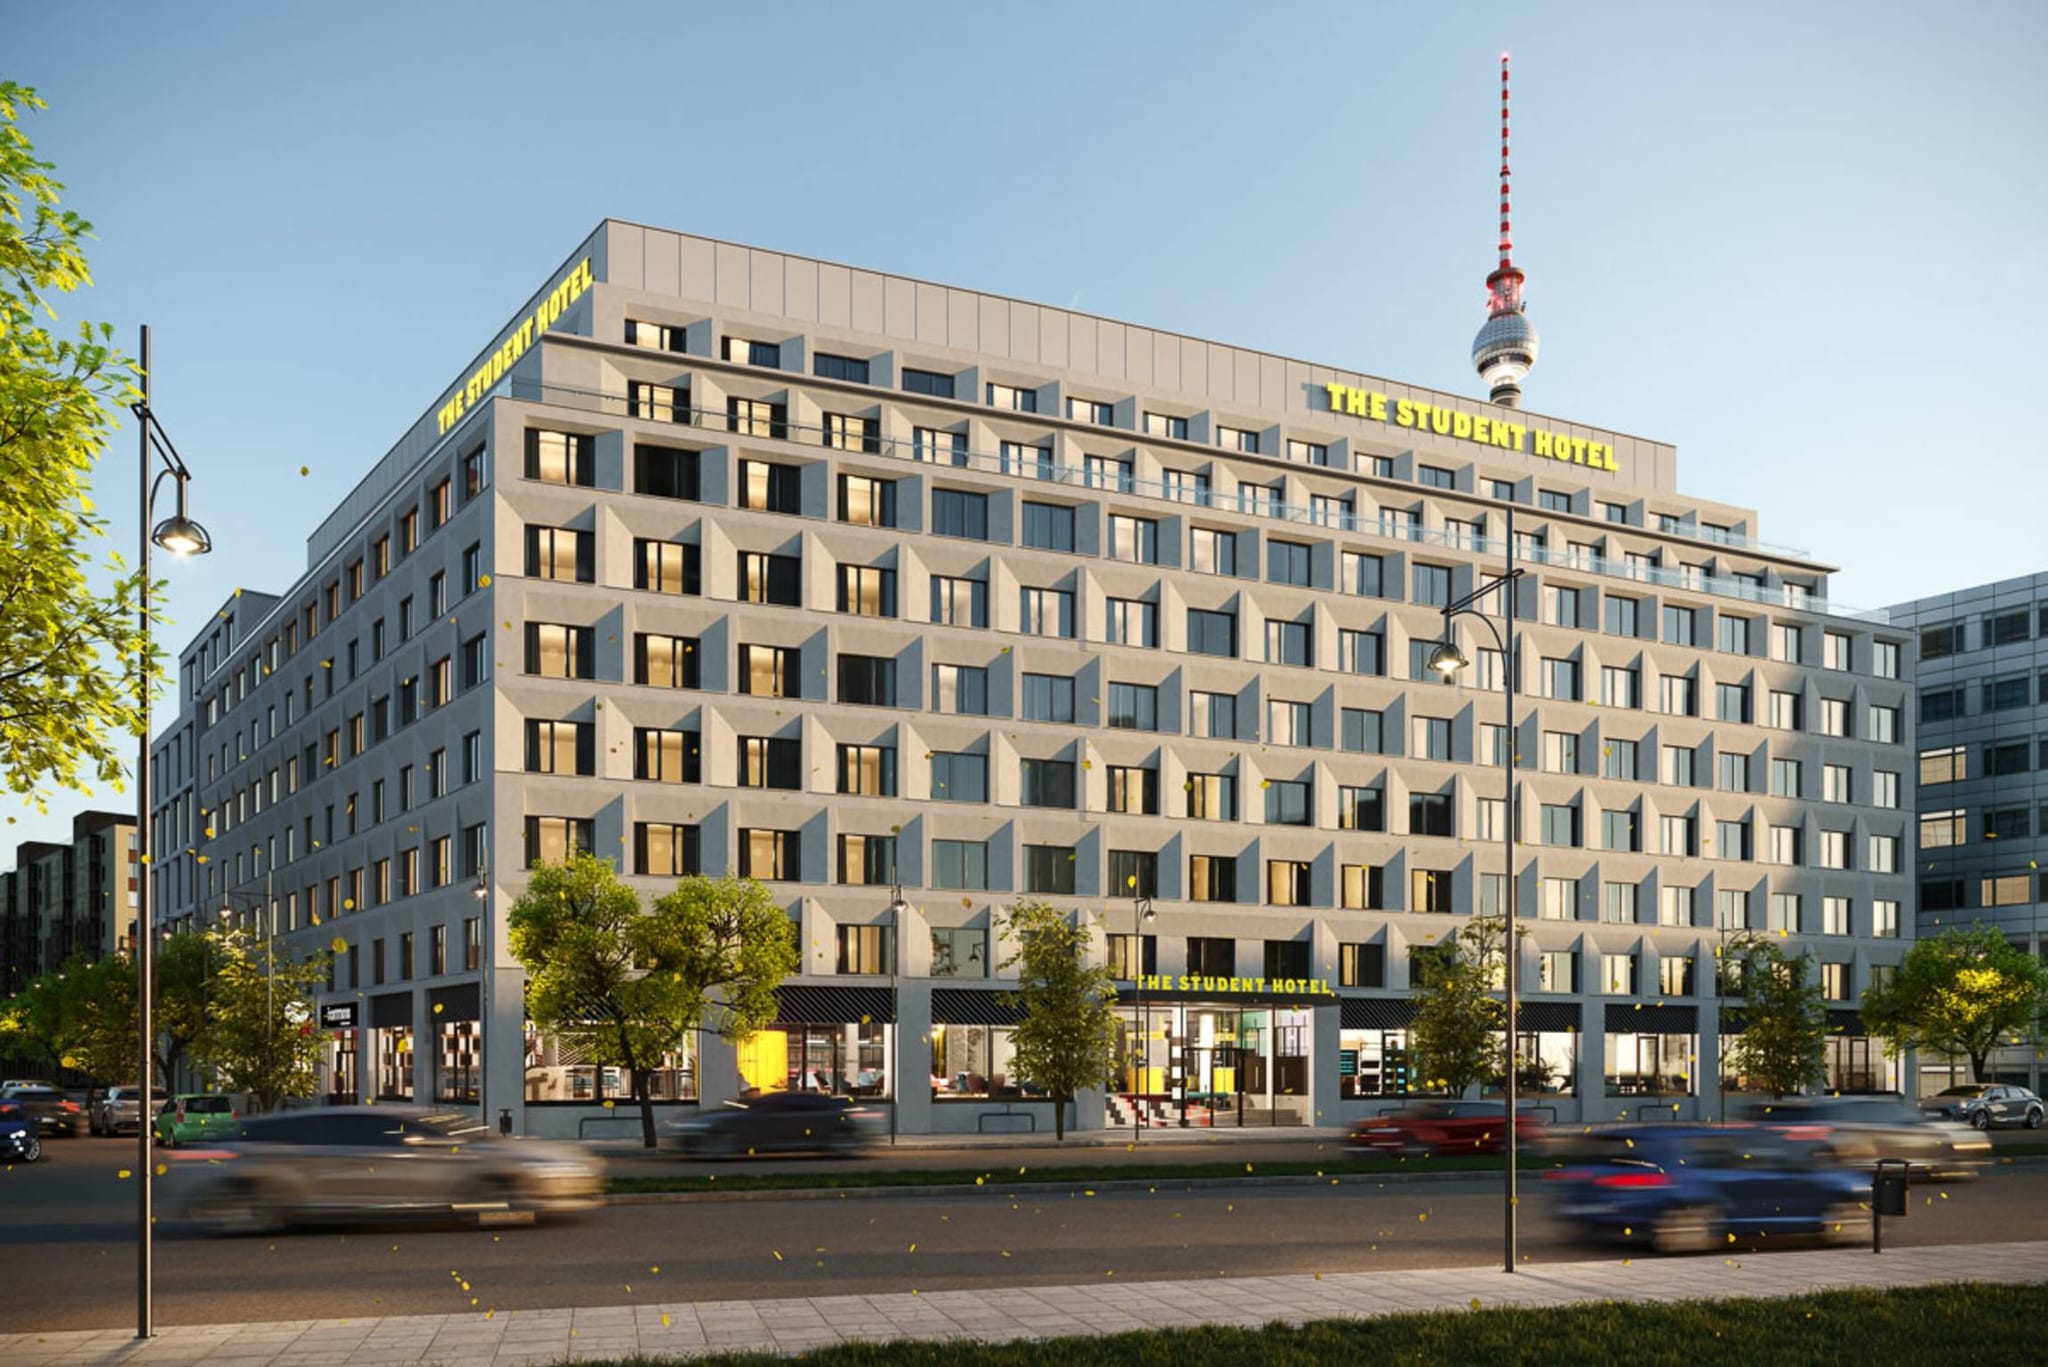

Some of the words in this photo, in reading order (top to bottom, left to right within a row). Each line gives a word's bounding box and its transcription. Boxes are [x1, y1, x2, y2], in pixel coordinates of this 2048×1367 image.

[438, 390, 466, 436] THE
[466, 316, 534, 407] STUDENT
[537, 256, 594, 336] HOTEL
[1326, 382, 1388, 421] THE
[1395, 399, 1527, 450] STUDENT
[1532, 428, 1620, 472] HOTEL
[1137, 974, 1173, 990] THE
[1178, 975, 1266, 993] STUDENT
[1272, 979, 1331, 995] HOTEL
